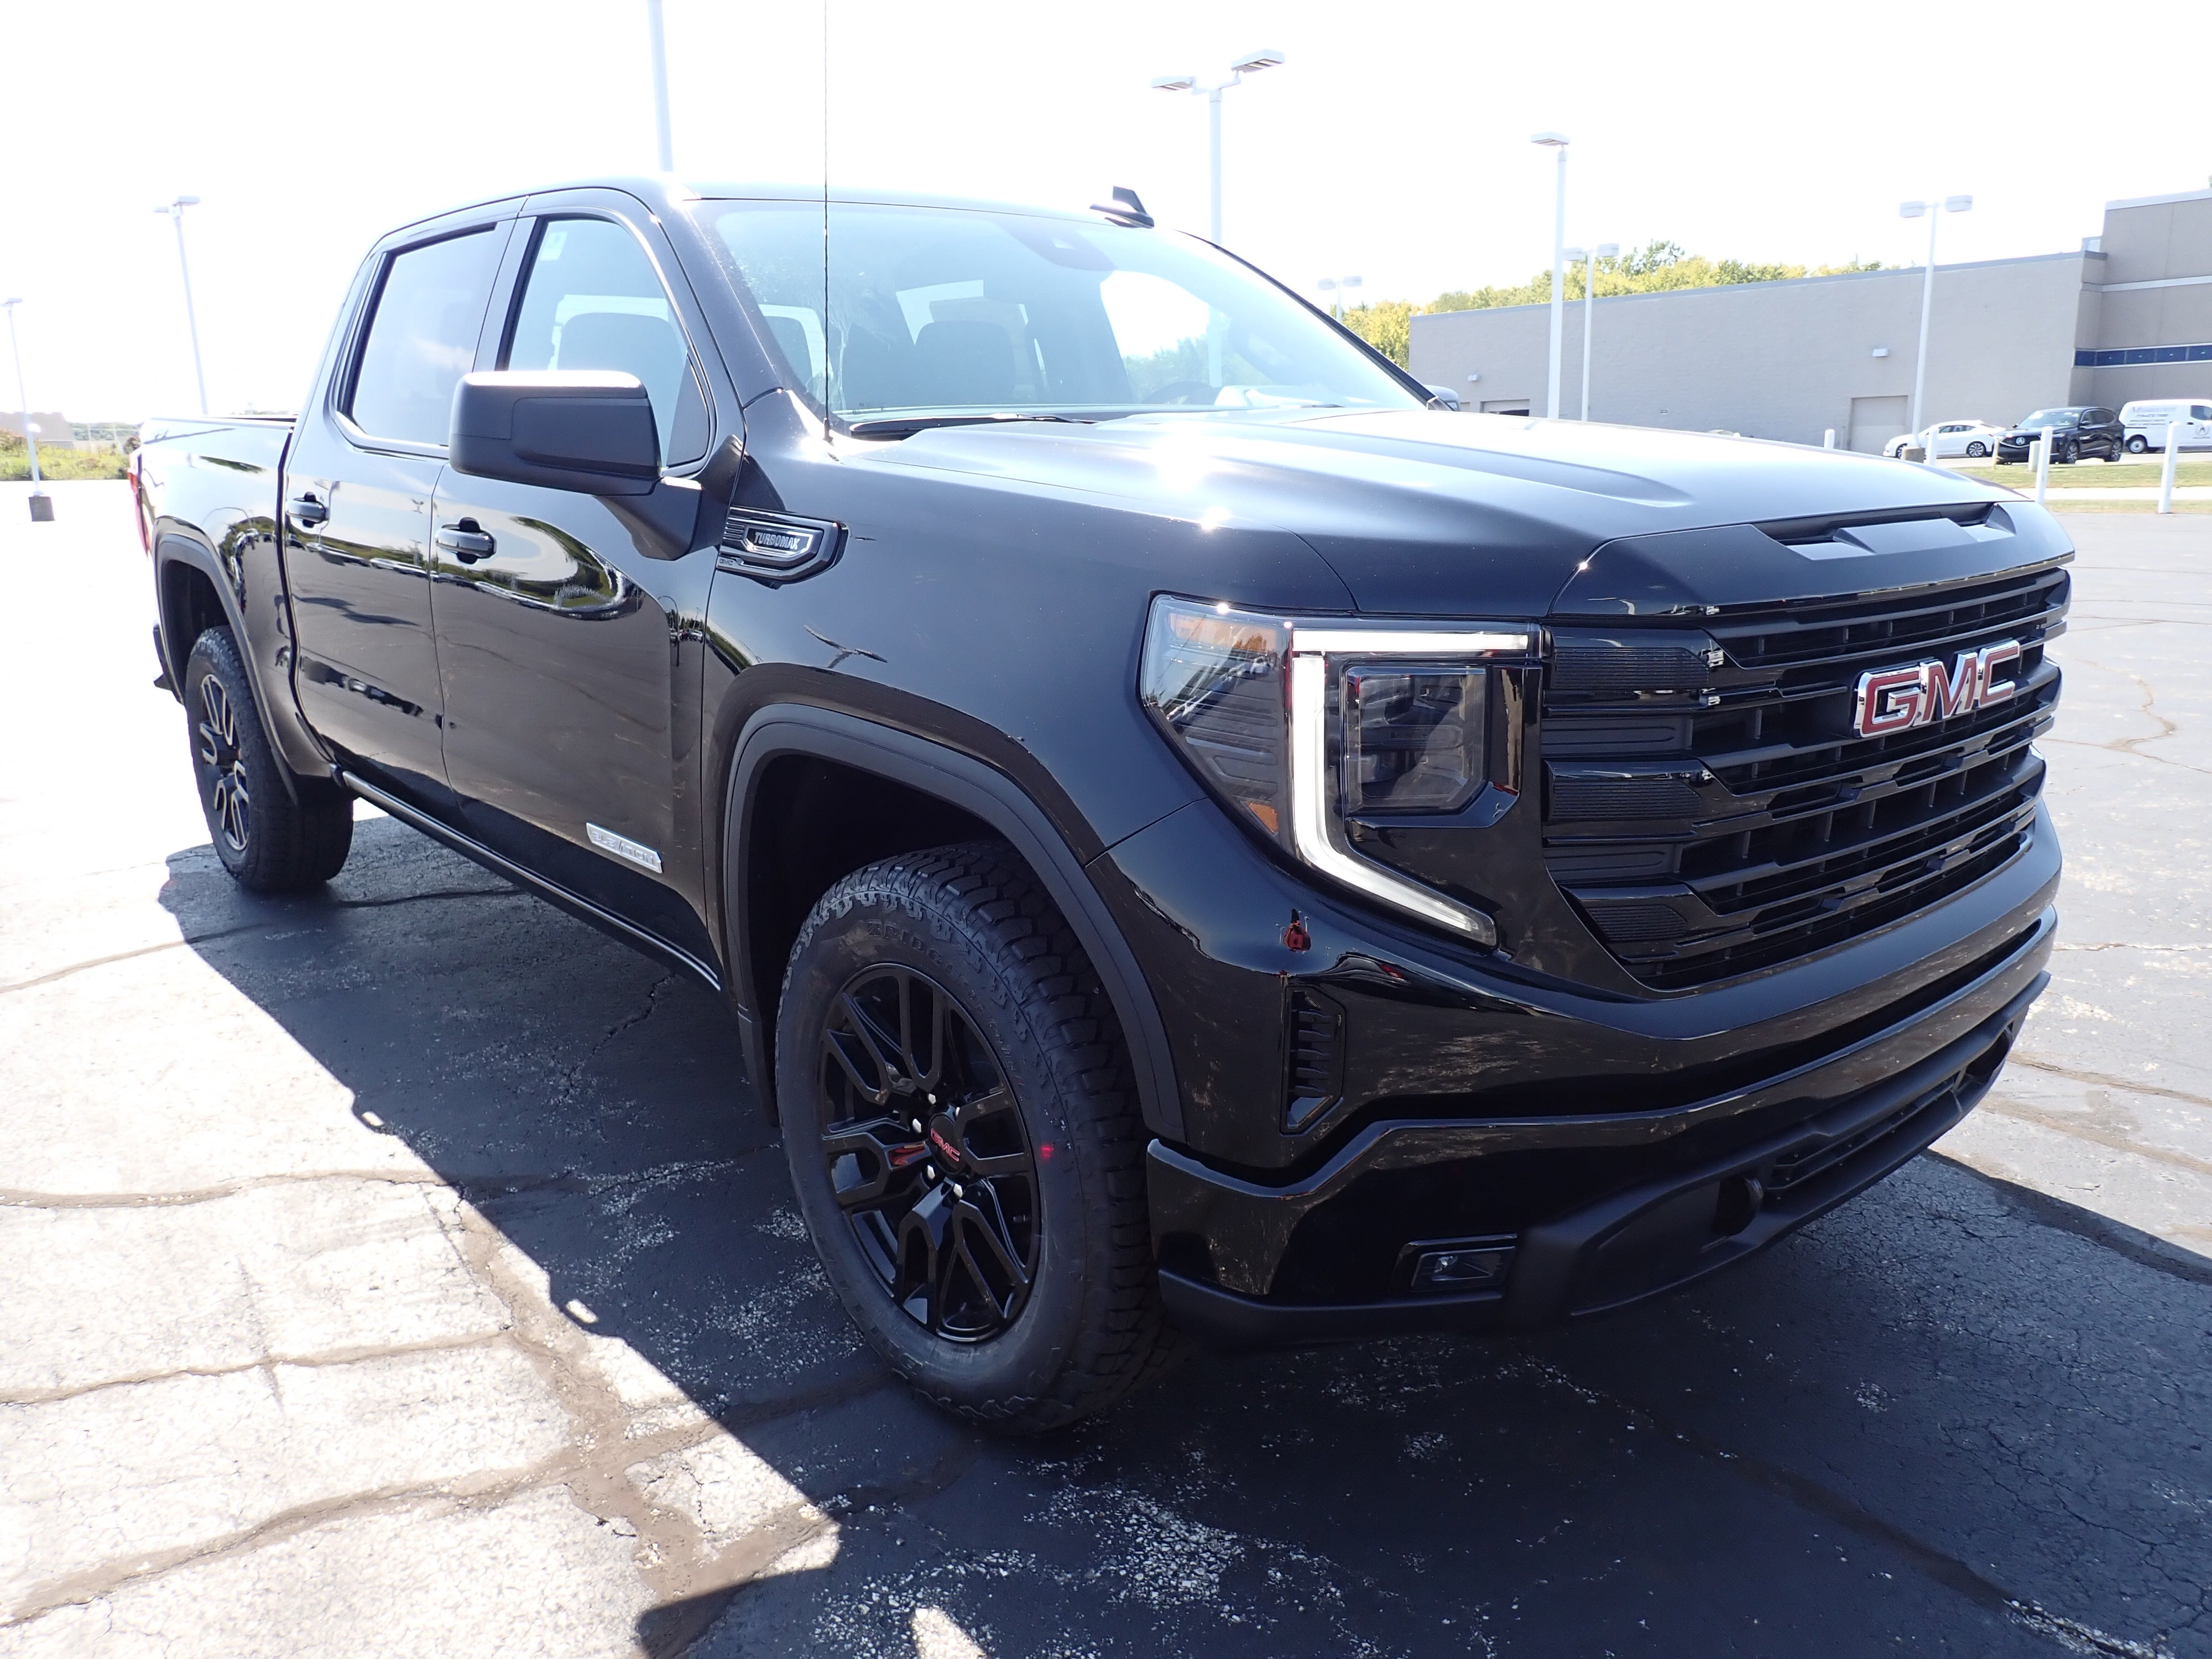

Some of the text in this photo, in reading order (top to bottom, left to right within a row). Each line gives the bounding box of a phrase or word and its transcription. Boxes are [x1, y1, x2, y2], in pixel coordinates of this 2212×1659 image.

[754, 532, 800, 550] TURBOMAX
[1854, 640, 2020, 738] GMC
[930, 1128, 960, 1162] GMC
